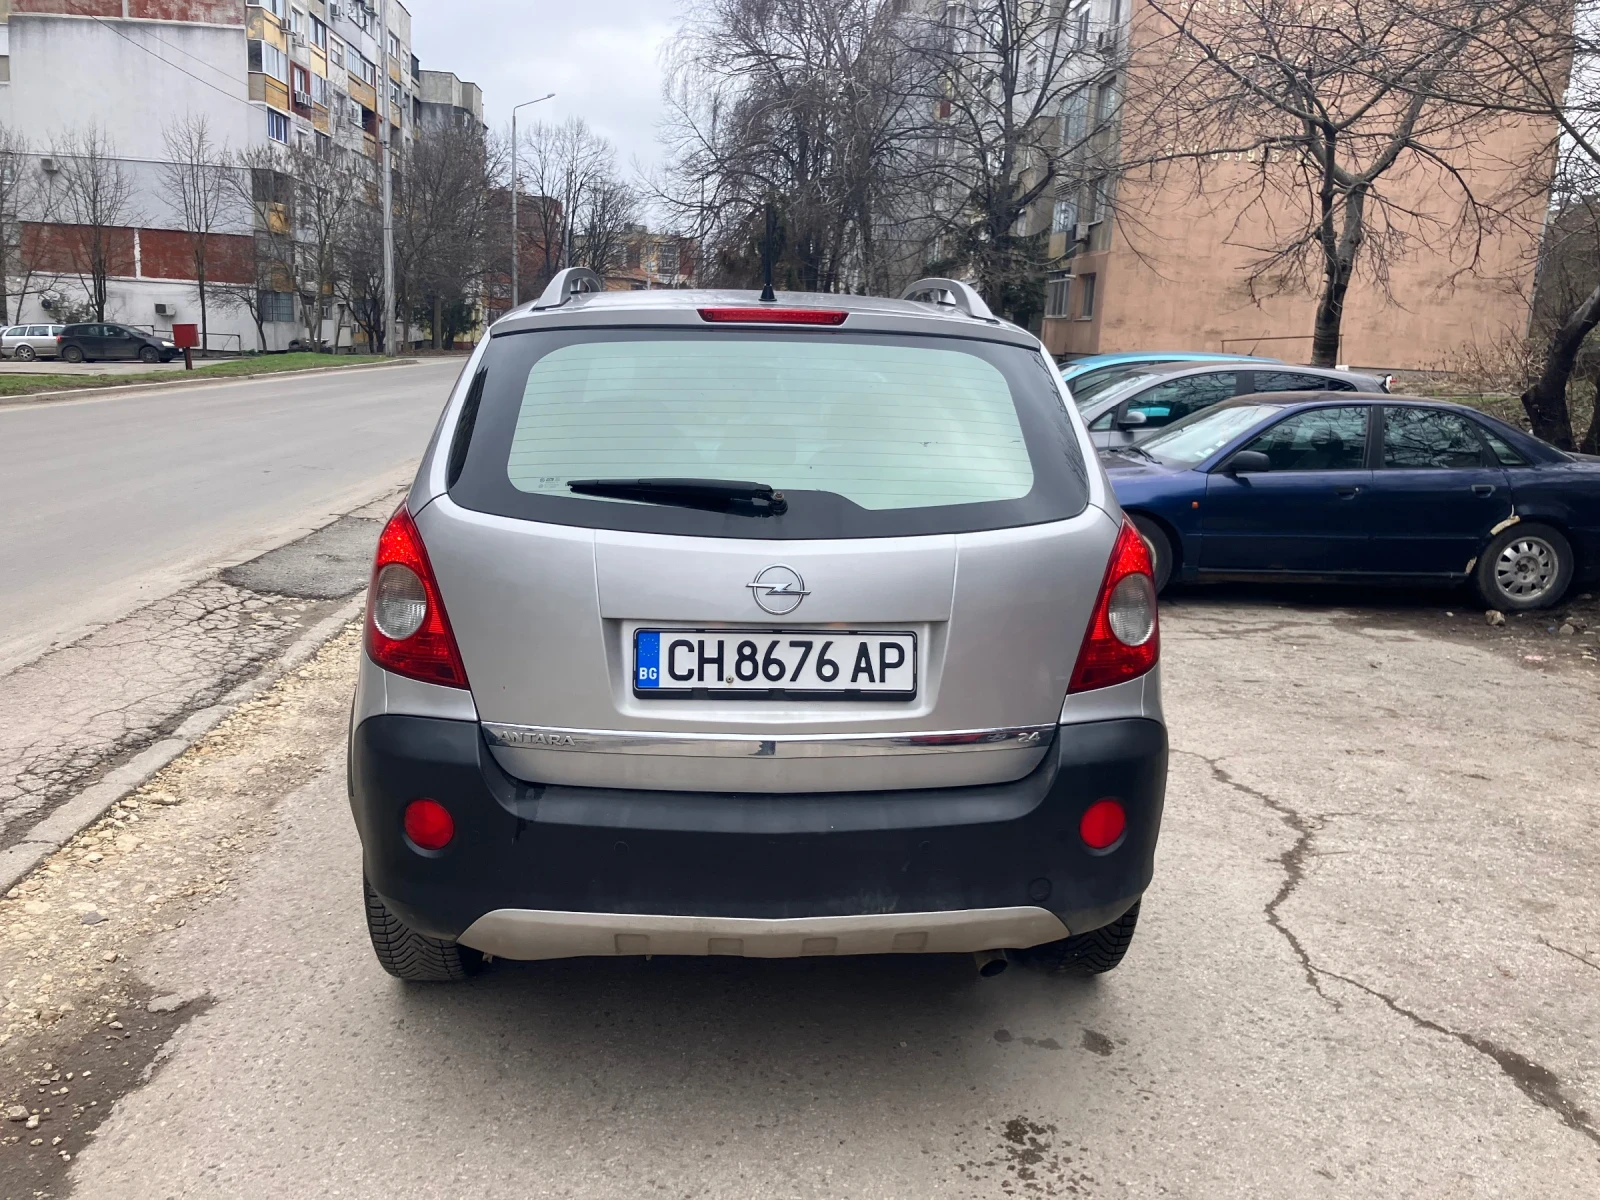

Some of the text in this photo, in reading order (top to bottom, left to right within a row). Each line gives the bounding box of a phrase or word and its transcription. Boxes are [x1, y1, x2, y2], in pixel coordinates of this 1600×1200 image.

[667, 639, 905, 683] CH 8676 AP
[639, 667, 657, 680] BG
[500, 730, 575, 746] ANTARA
